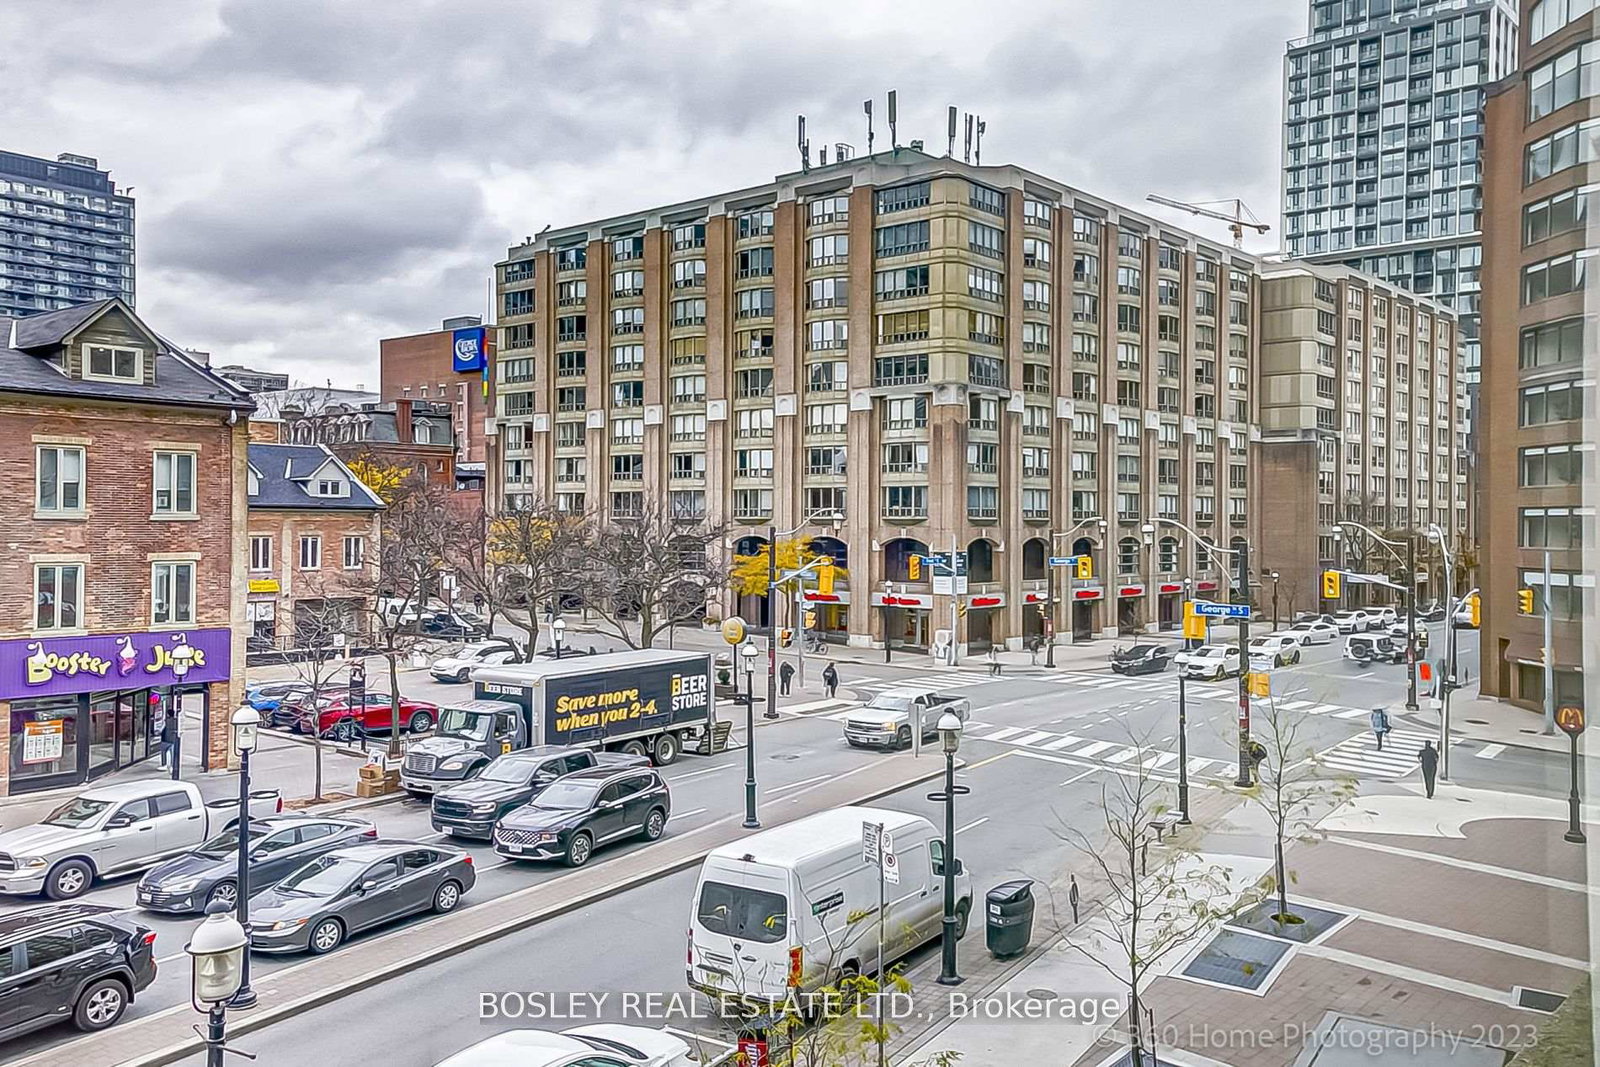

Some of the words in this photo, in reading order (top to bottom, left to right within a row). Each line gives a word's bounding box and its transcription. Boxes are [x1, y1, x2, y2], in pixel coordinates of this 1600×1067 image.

[1201, 604, 1231, 616] George
[27, 641, 112, 683] Booster
[146, 633, 207, 672] Jue
[671, 673, 707, 697] BEER
[556, 695, 596, 713] Save
[598, 688, 639, 707] more
[672, 692, 707, 711] STORE
[556, 712, 600, 732] when
[600, 707, 629, 728] you
